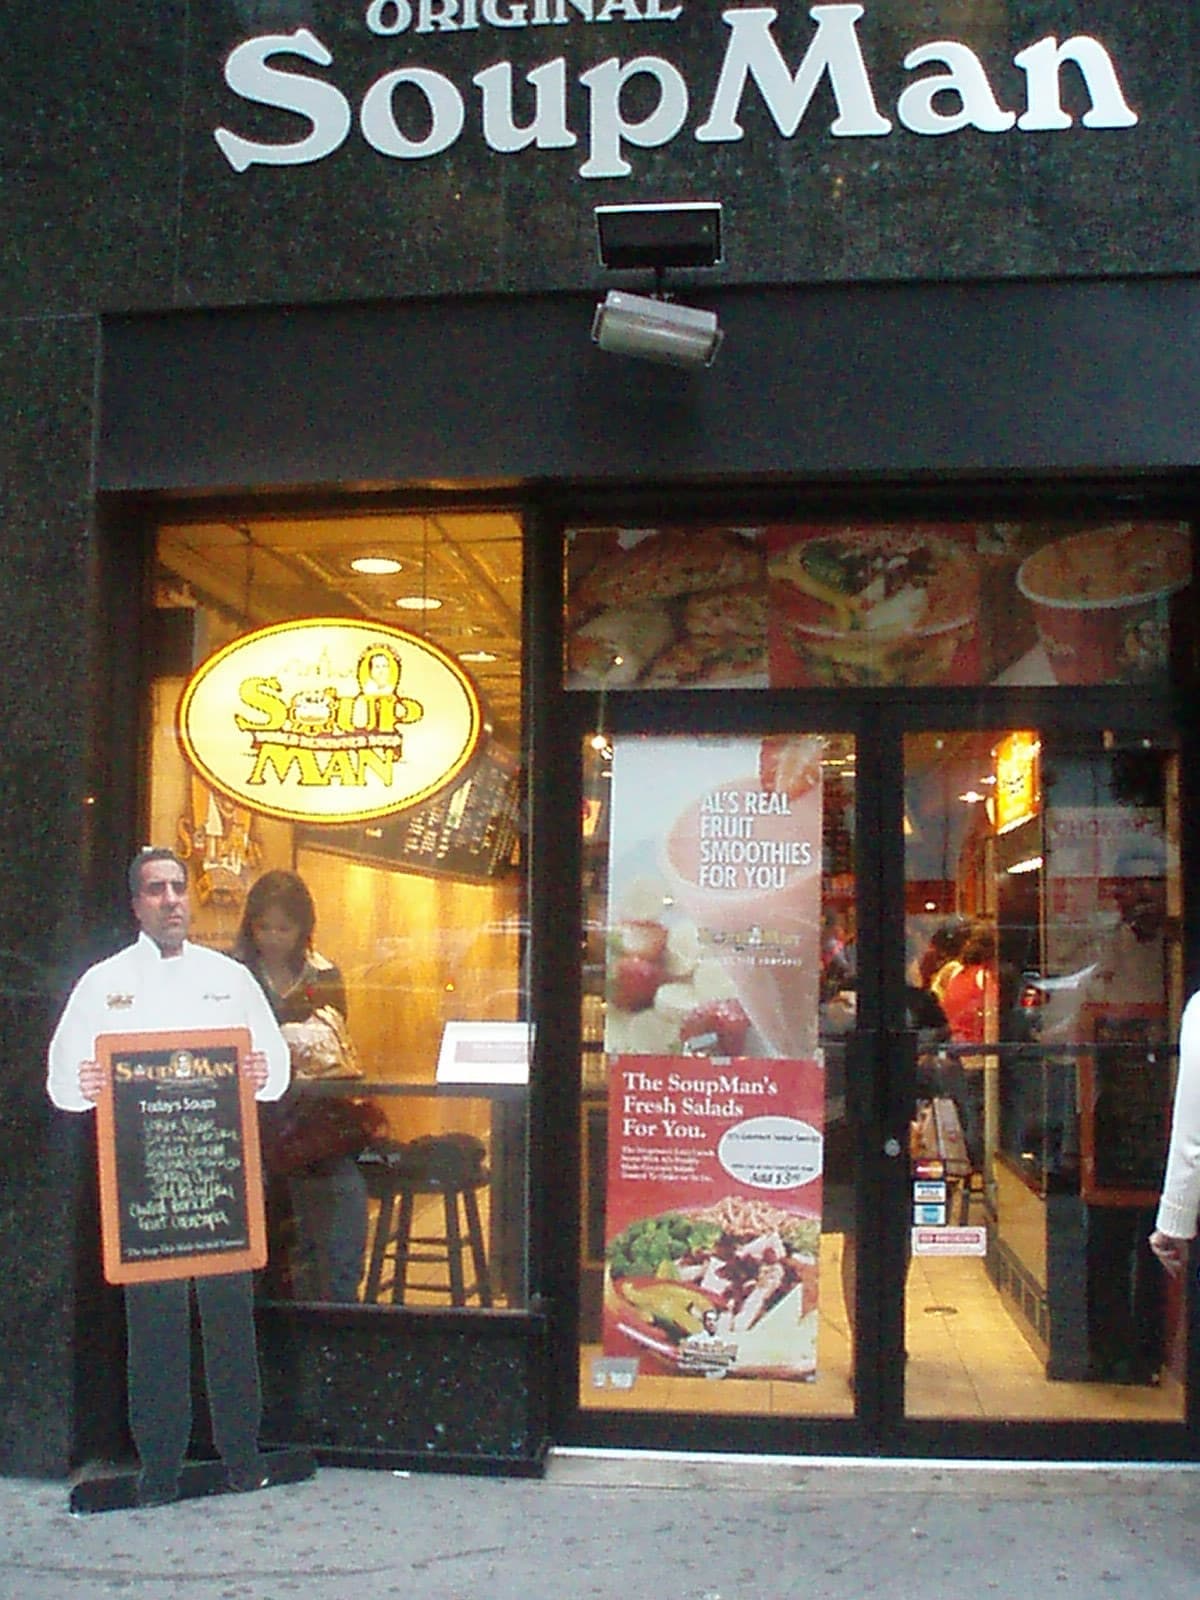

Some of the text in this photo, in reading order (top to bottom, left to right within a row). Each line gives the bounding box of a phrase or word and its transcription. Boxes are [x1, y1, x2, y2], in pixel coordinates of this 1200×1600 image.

[365, 0, 683, 36] ORIGINAL
[213, 3, 1139, 178] SoupMan
[246, 744, 394, 787] MAN
[701, 791, 793, 816] AL'S REAL
[701, 815, 754, 839] FRUIT
[700, 839, 812, 866] SMOOTHIES
[699, 865, 787, 890] FOR YOU
[622, 1072, 778, 1098] The SoupMan's
[623, 1095, 744, 1118] Fresh Salads
[622, 1118, 659, 1138] For
[661, 1119, 707, 1139] You.
